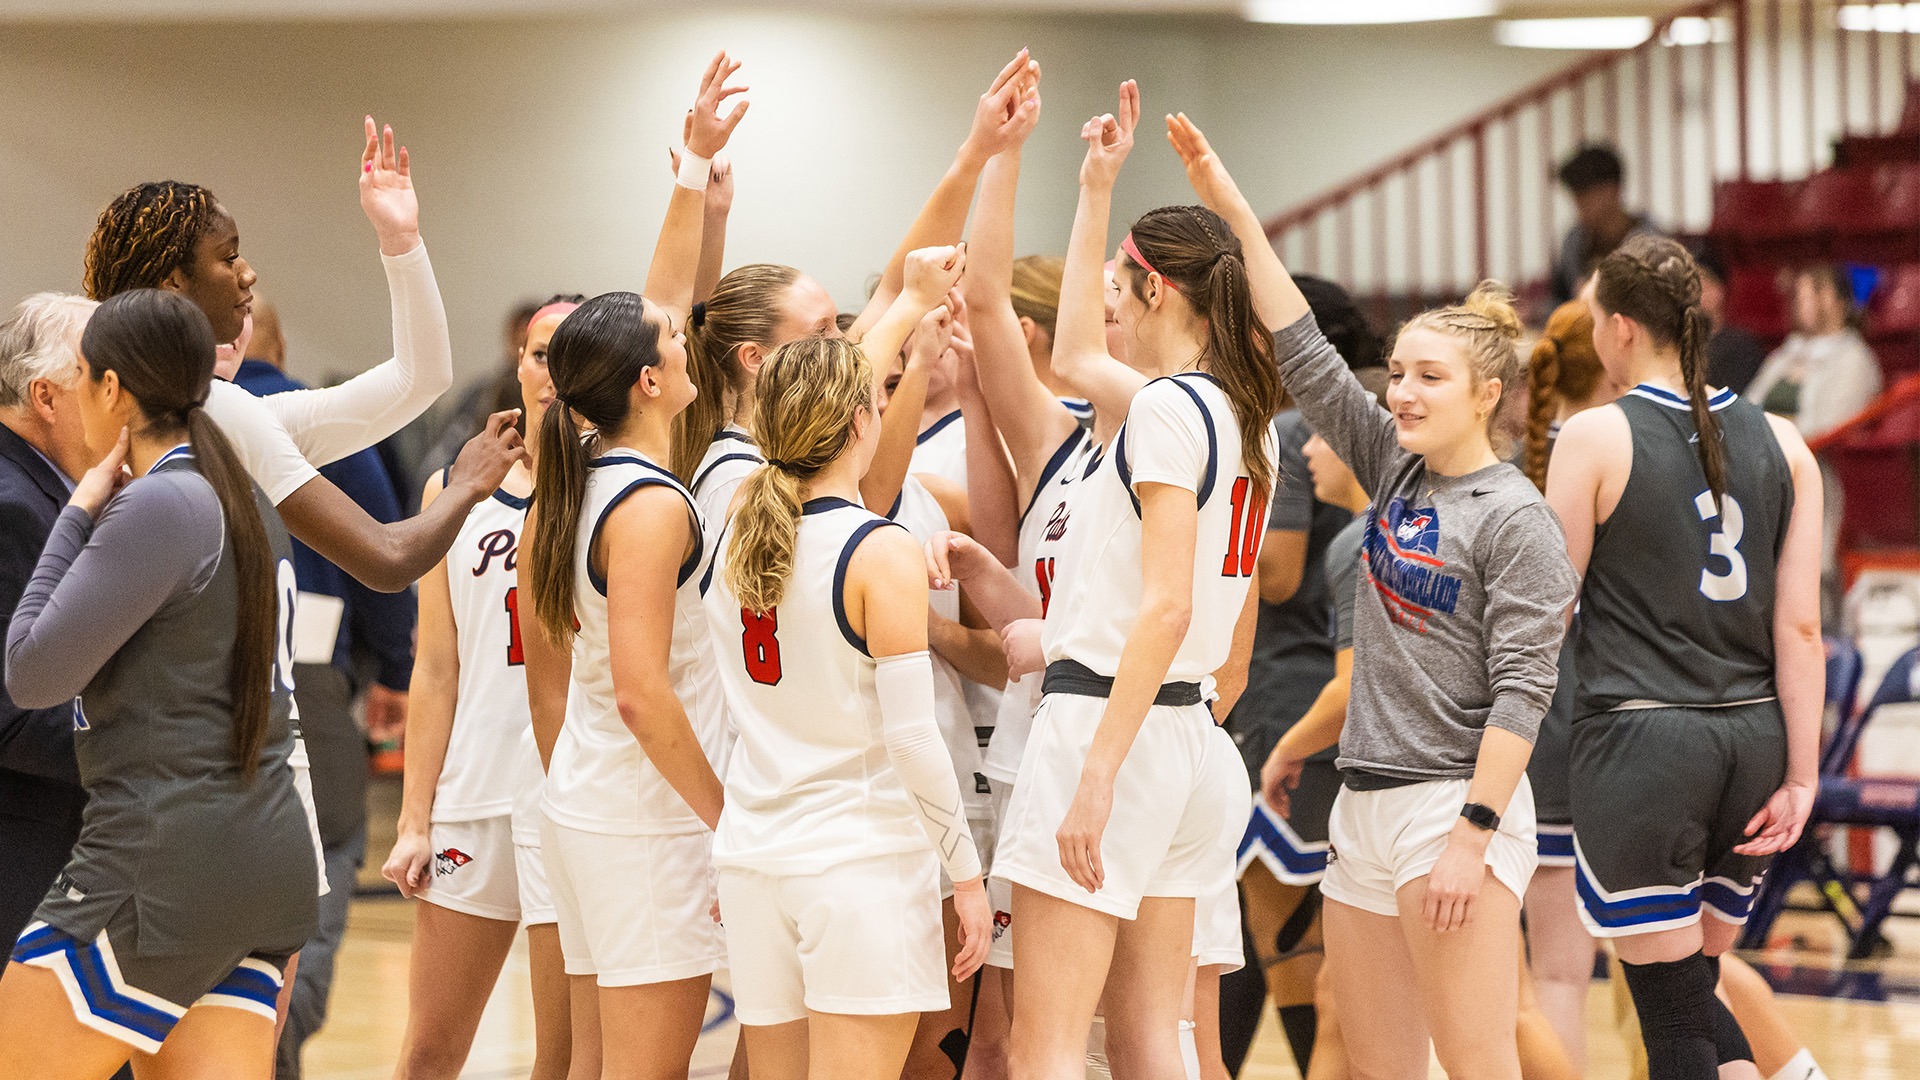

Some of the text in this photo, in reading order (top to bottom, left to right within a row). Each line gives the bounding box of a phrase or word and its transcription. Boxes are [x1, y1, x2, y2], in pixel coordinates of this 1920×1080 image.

[1221, 476, 1269, 577] 10
[1693, 488, 1748, 602] 3
[270, 558, 298, 693] 0
[740, 600, 783, 687] 8
